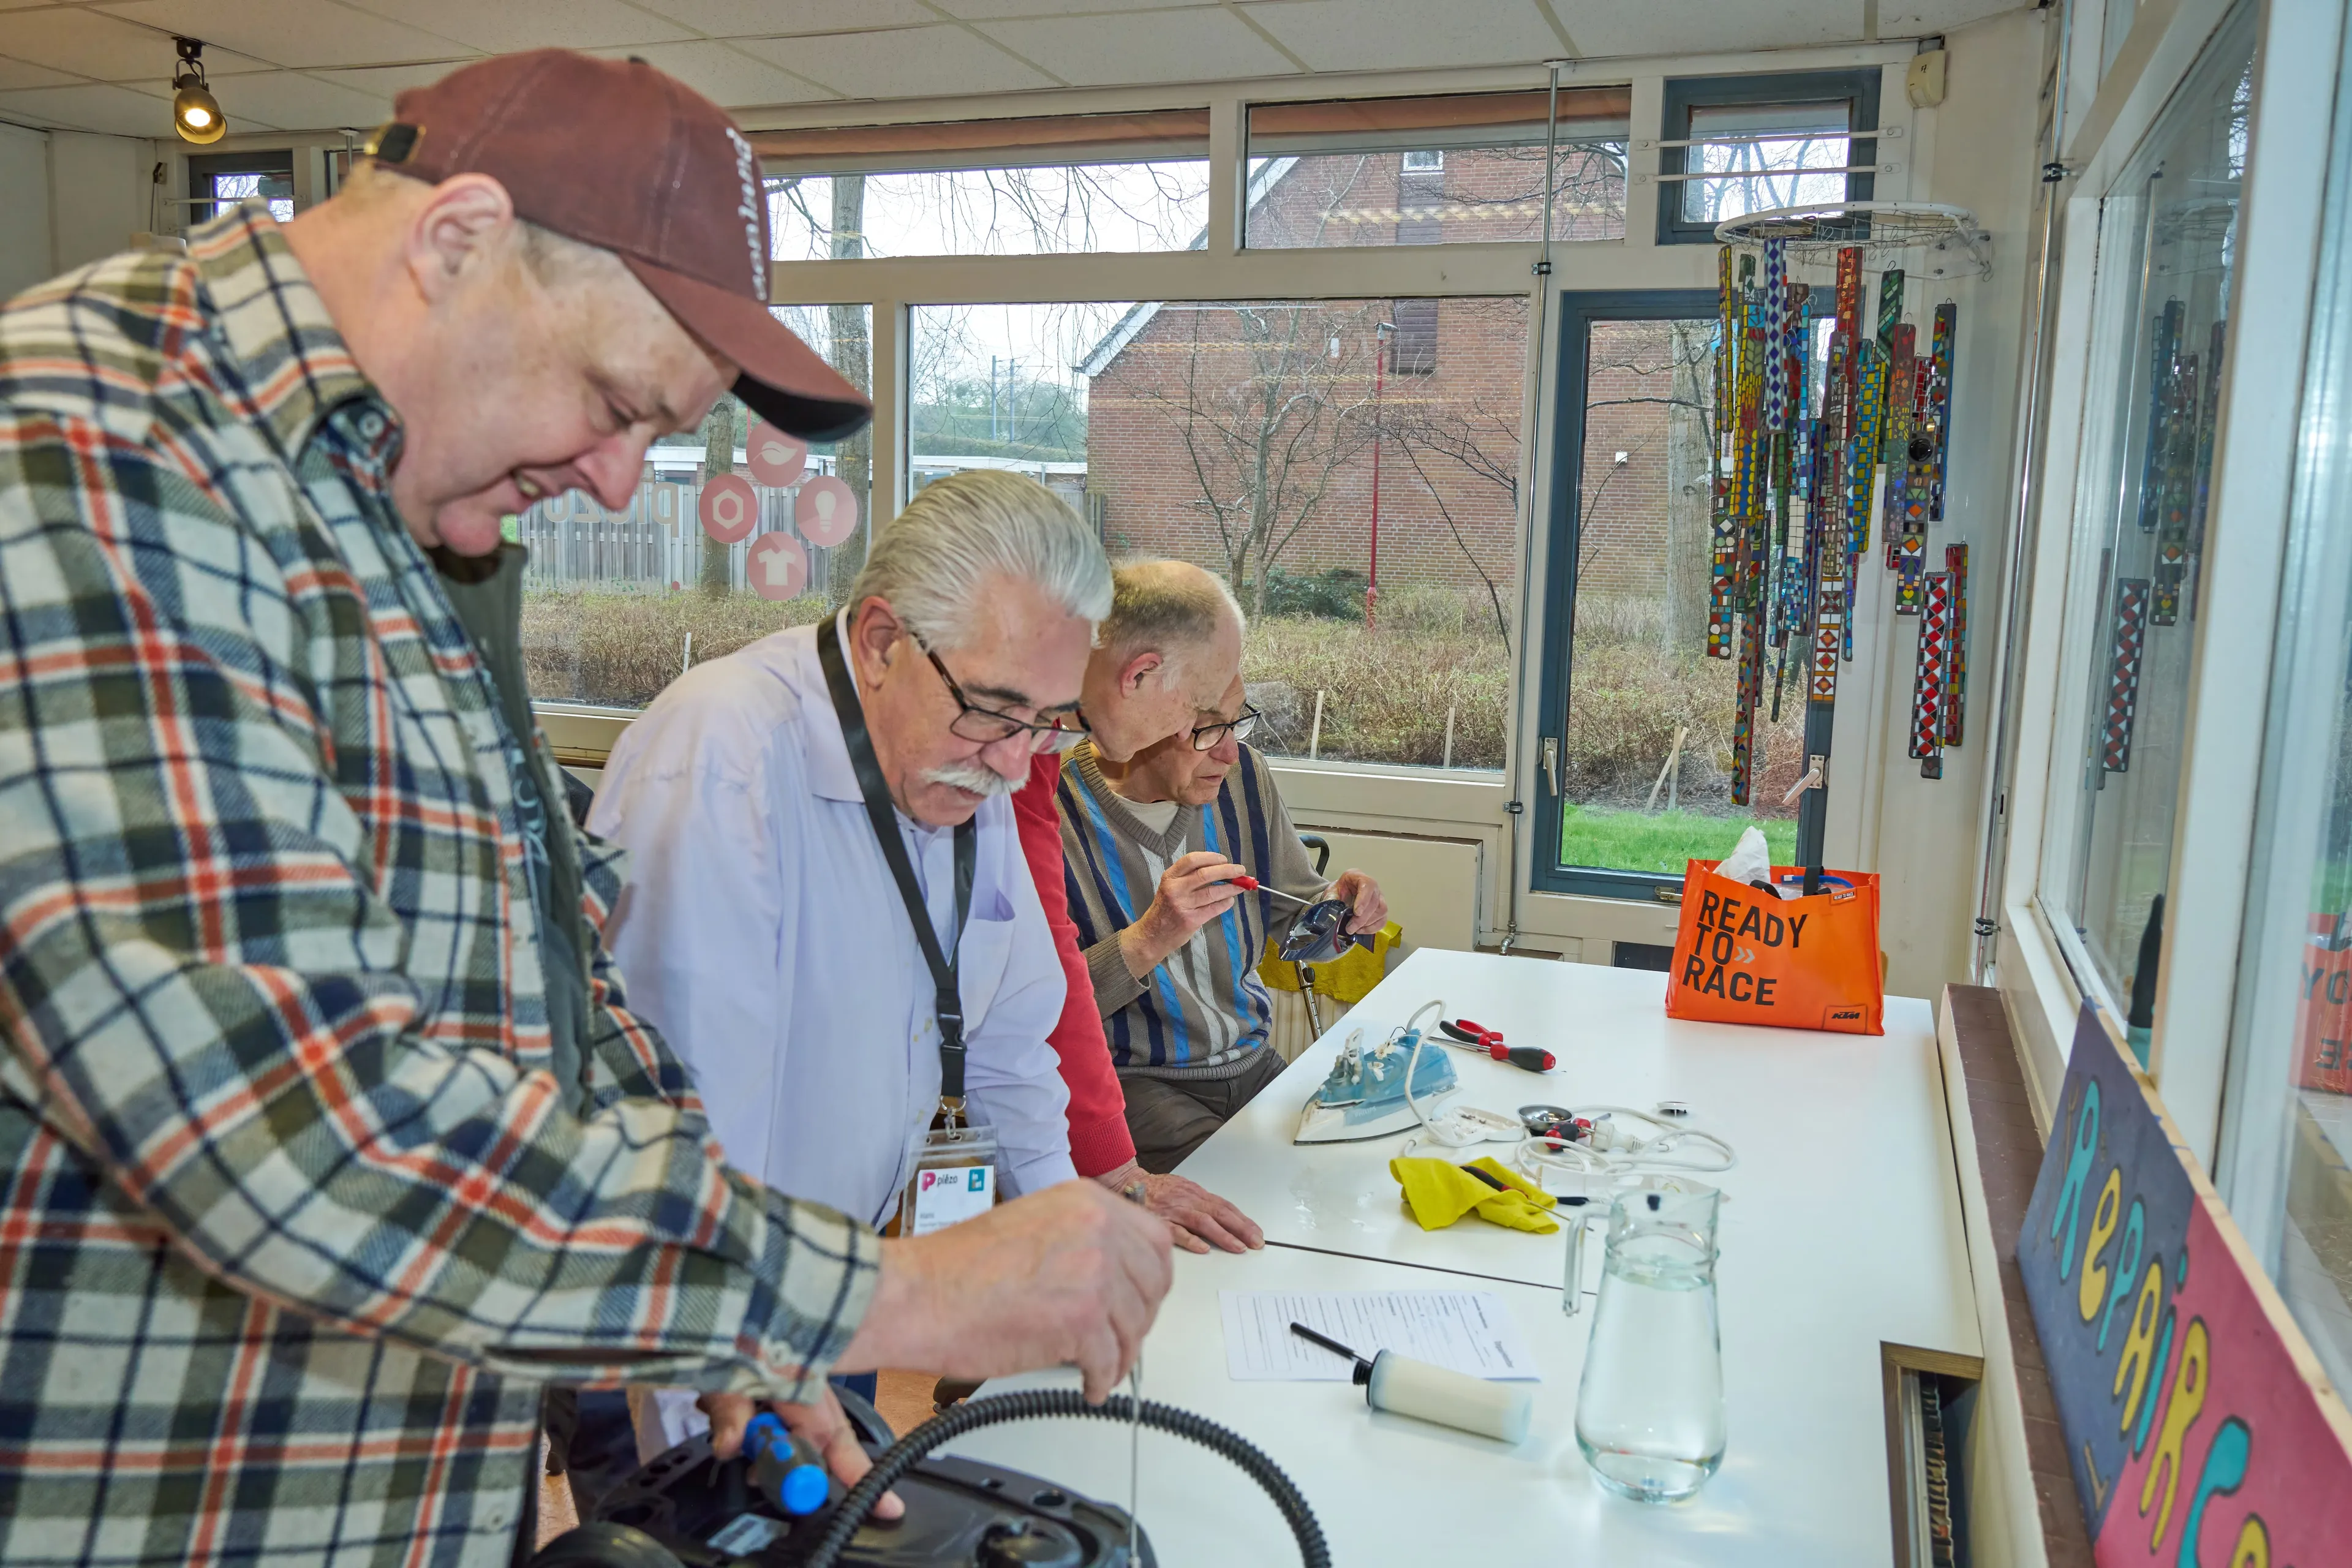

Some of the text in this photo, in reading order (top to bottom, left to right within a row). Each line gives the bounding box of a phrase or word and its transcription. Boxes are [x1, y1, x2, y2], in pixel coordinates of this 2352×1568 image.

[1694, 922, 1734, 965] TO
[1698, 889, 1808, 949] READY
[1683, 954, 1777, 1006] RACE
